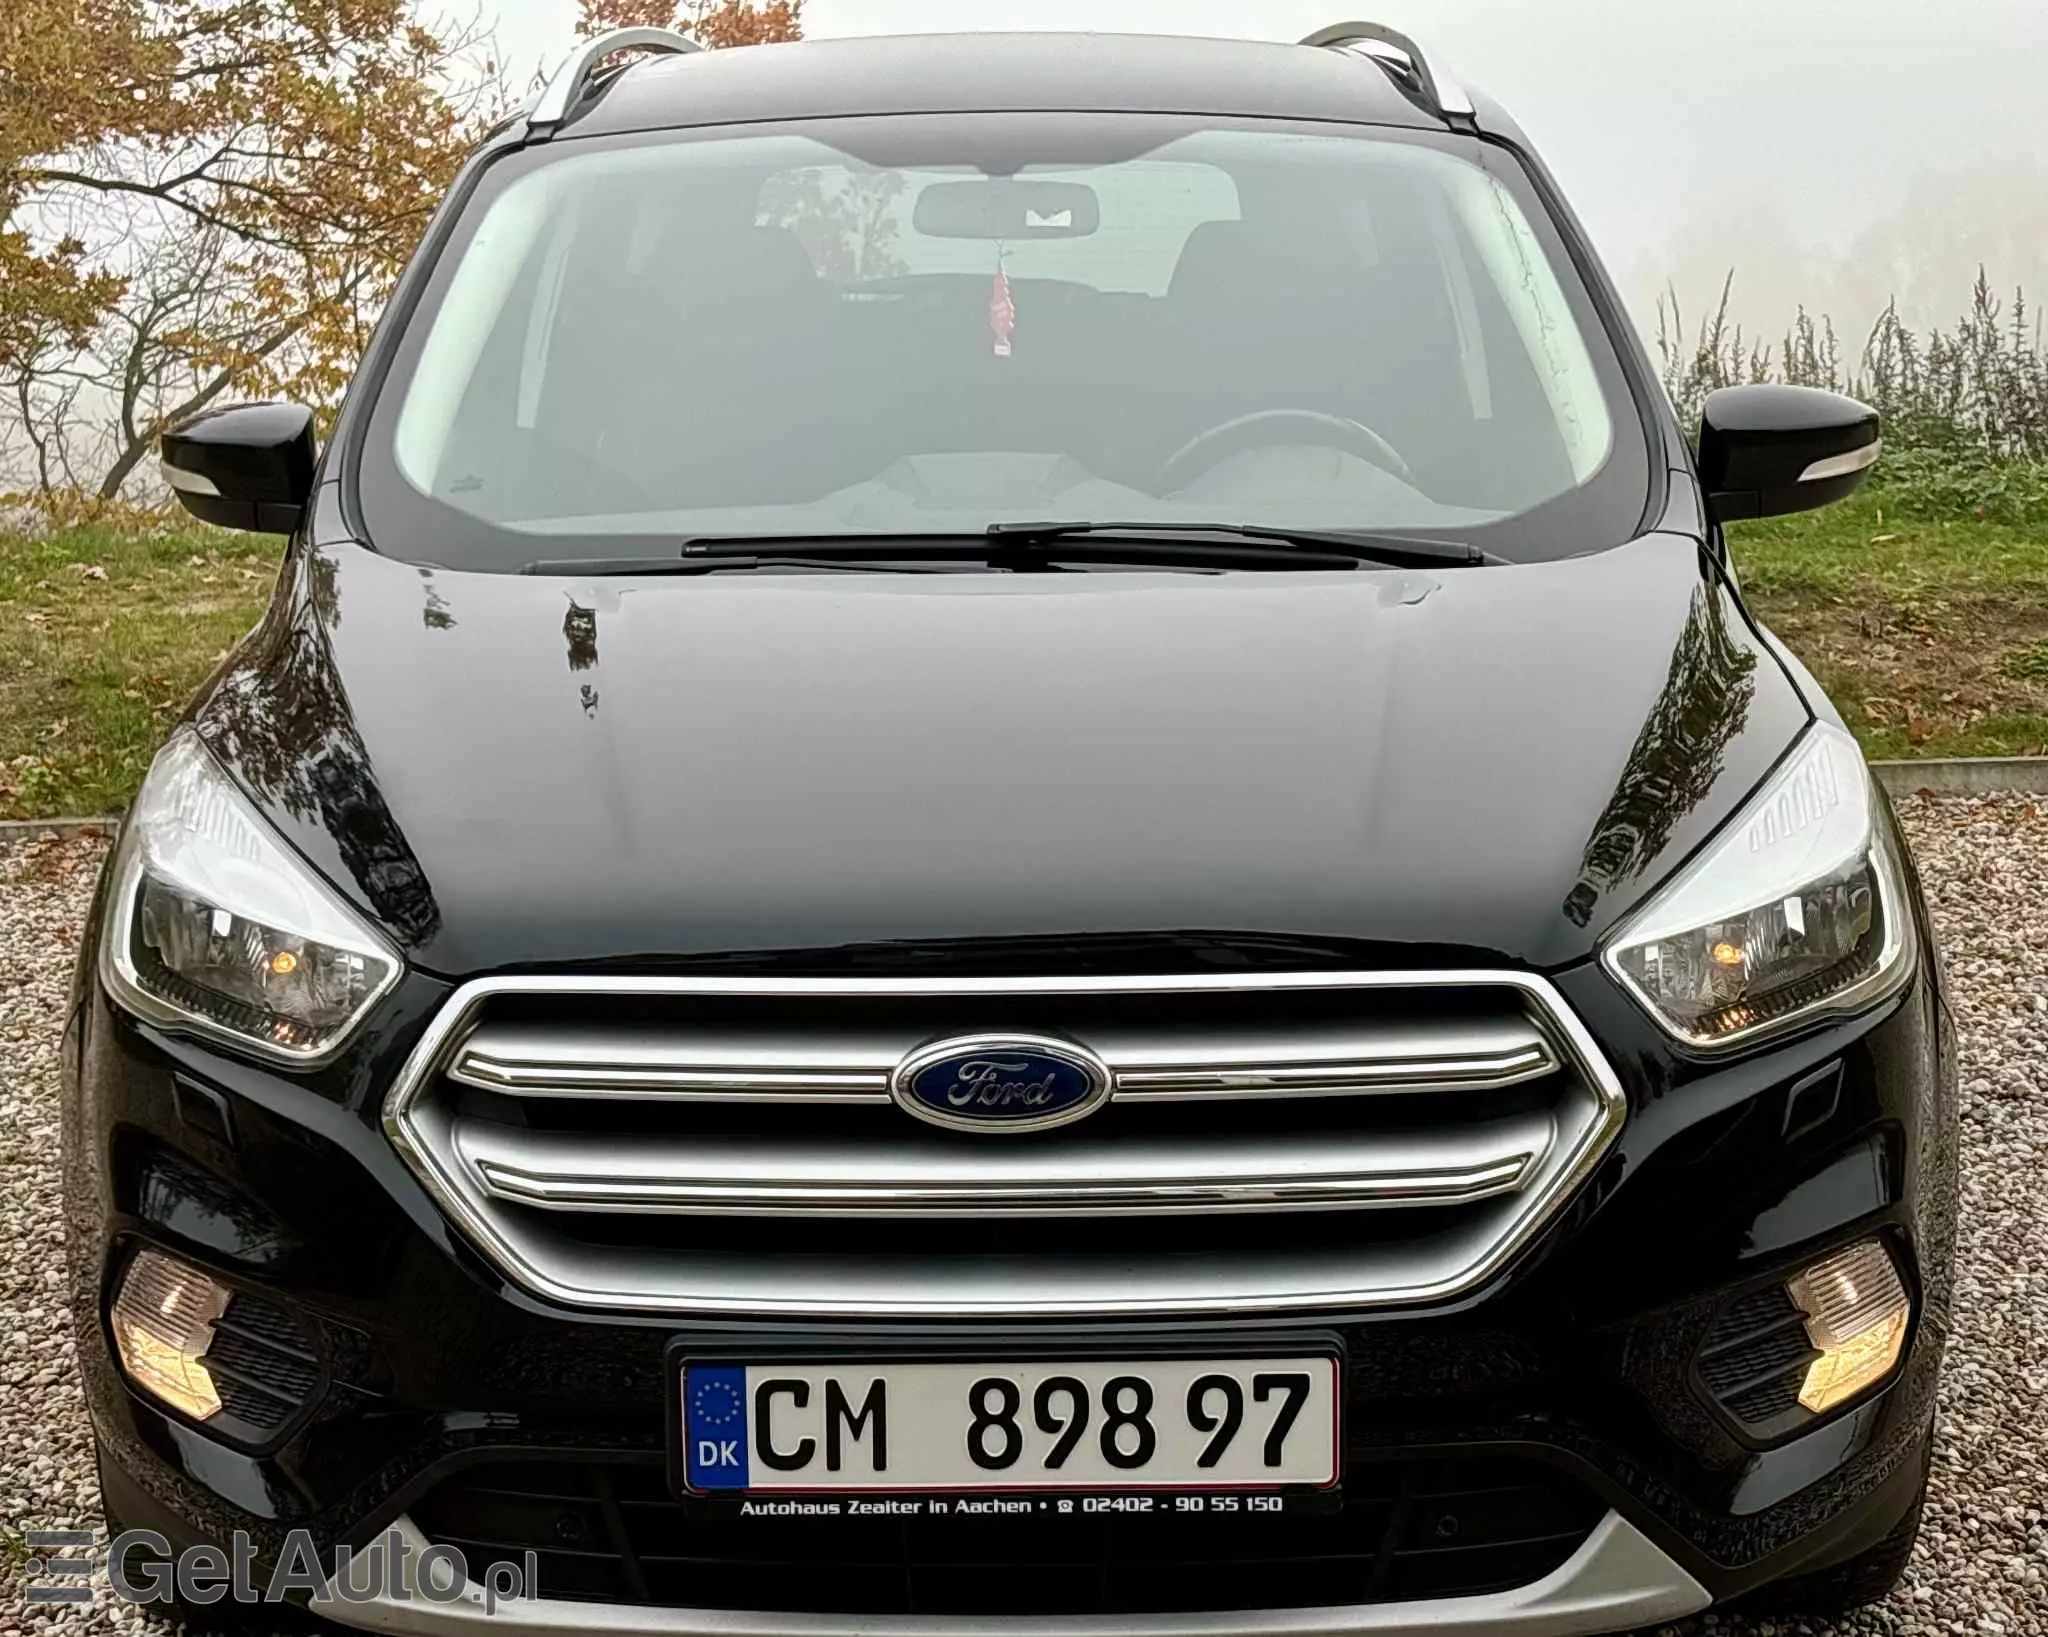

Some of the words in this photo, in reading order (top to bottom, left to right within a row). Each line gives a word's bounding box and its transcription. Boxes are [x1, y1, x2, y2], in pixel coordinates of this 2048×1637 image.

[947, 1060, 1055, 1106] Ford
[754, 1378, 887, 1472] CM
[967, 1376, 1156, 1471] 898
[1186, 1373, 1311, 1469] 97
[698, 1440, 740, 1468] DK
[740, 1501, 841, 1516] Autohaus
[847, 1500, 923, 1515] Zeaiter
[955, 1499, 1032, 1514] Aachen
[1082, 1497, 1153, 1512] 02402
[1175, 1497, 1204, 1512] 90
[1211, 1496, 1239, 1512] 55
[1246, 1496, 1283, 1512] 150
